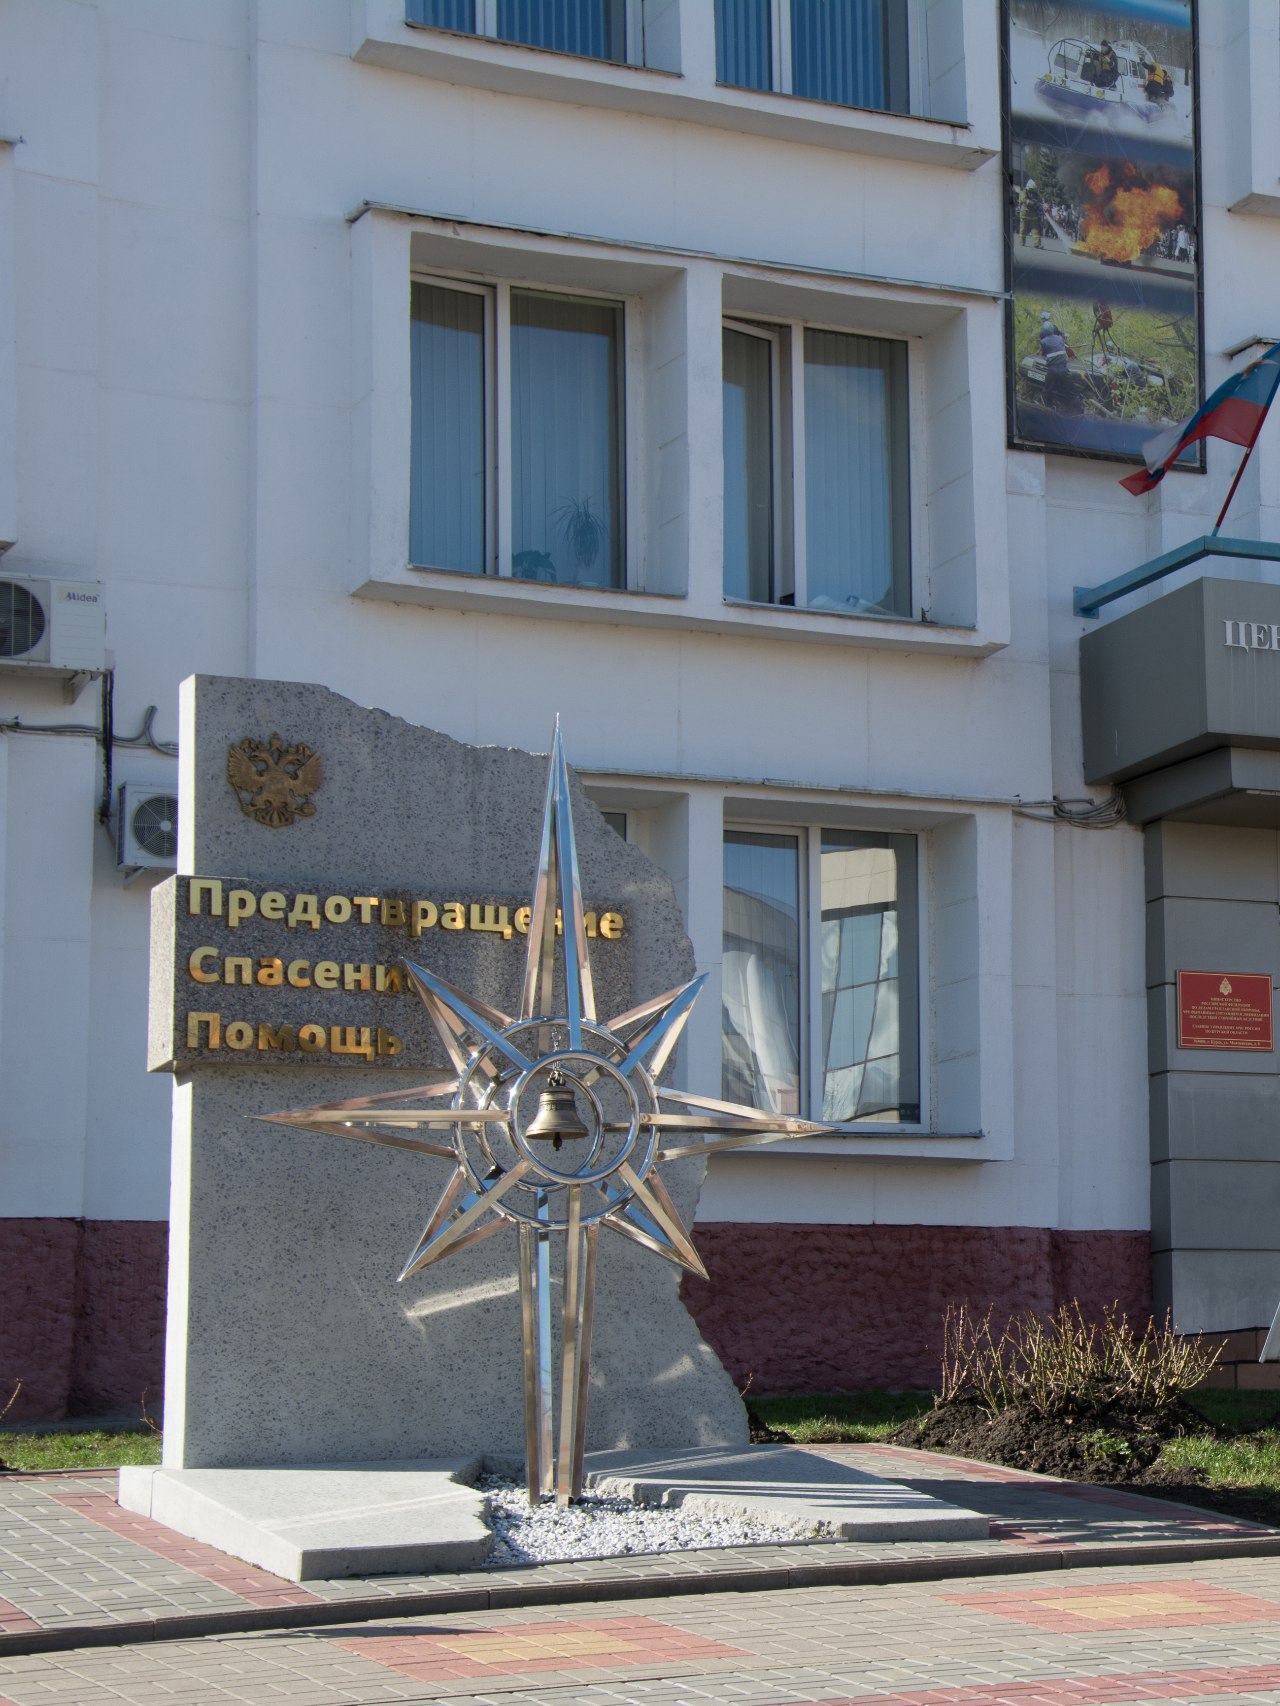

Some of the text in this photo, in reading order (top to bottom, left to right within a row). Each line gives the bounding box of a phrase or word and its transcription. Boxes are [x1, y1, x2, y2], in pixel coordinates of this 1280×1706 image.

[64, 591, 99, 603] Midea
[188, 878, 625, 940] Предотвращеие
[188, 946, 416, 994] Спасени
[186, 1011, 402, 1062] Помощь
